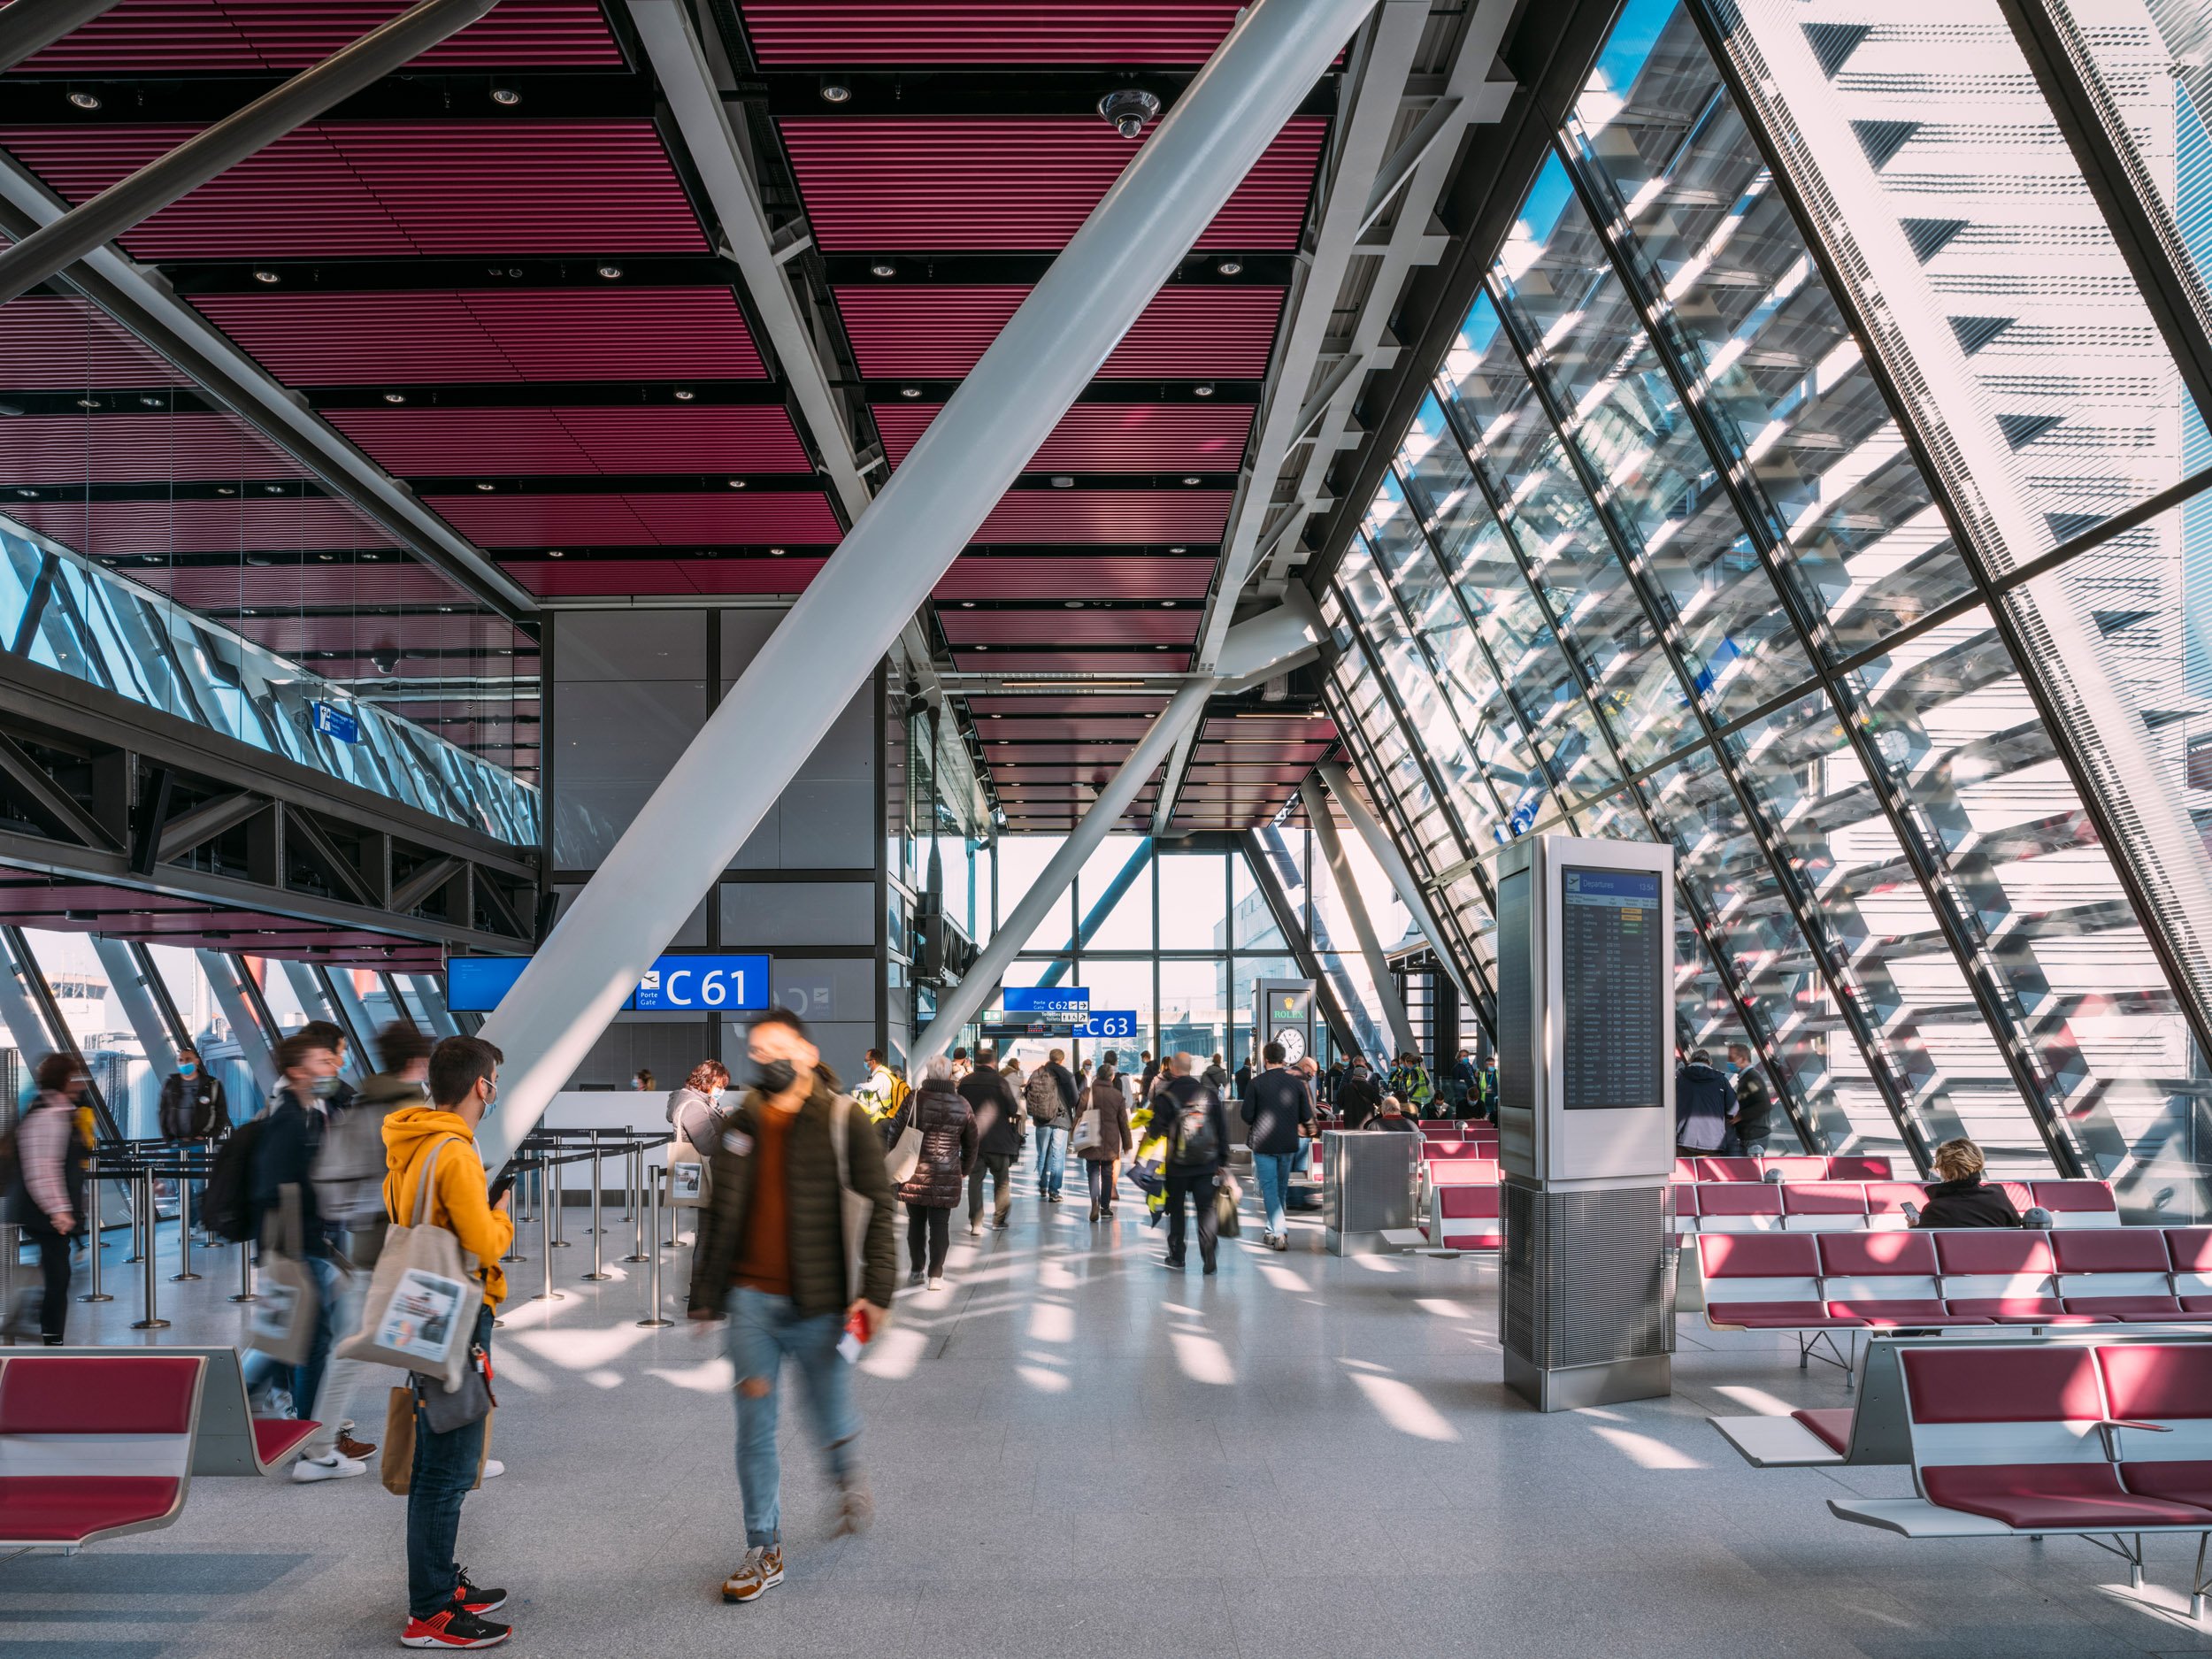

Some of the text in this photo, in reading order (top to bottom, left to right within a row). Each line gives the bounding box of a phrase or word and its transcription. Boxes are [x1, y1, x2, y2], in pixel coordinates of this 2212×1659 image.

[1583, 879, 1615, 889] Departures
[666, 970, 744, 1006] C 61
[1048, 1001, 1068, 1010] C 62
[1087, 1018, 1128, 1035] C 63
